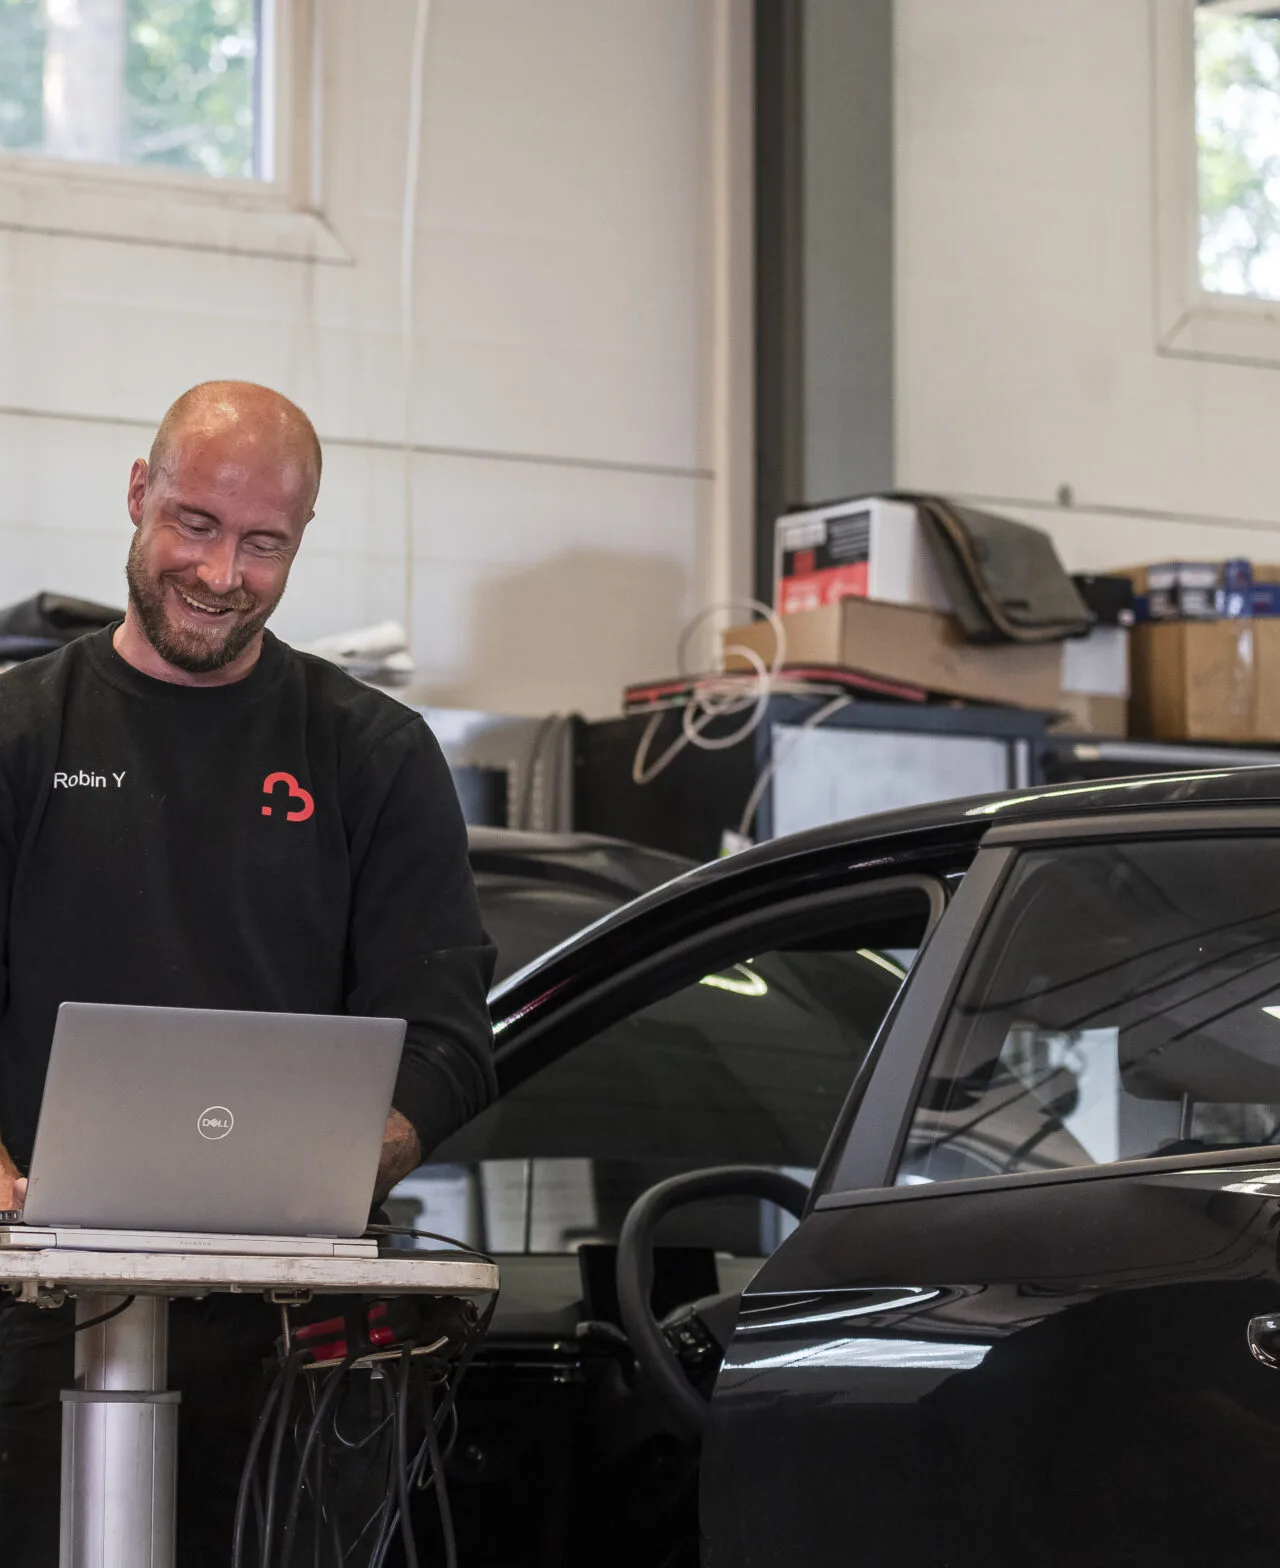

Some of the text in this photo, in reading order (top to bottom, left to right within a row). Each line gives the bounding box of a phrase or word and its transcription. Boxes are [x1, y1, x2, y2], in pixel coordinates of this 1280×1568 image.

[53, 770, 126, 789] Robin Y
[202, 1118, 229, 1128] DELL
